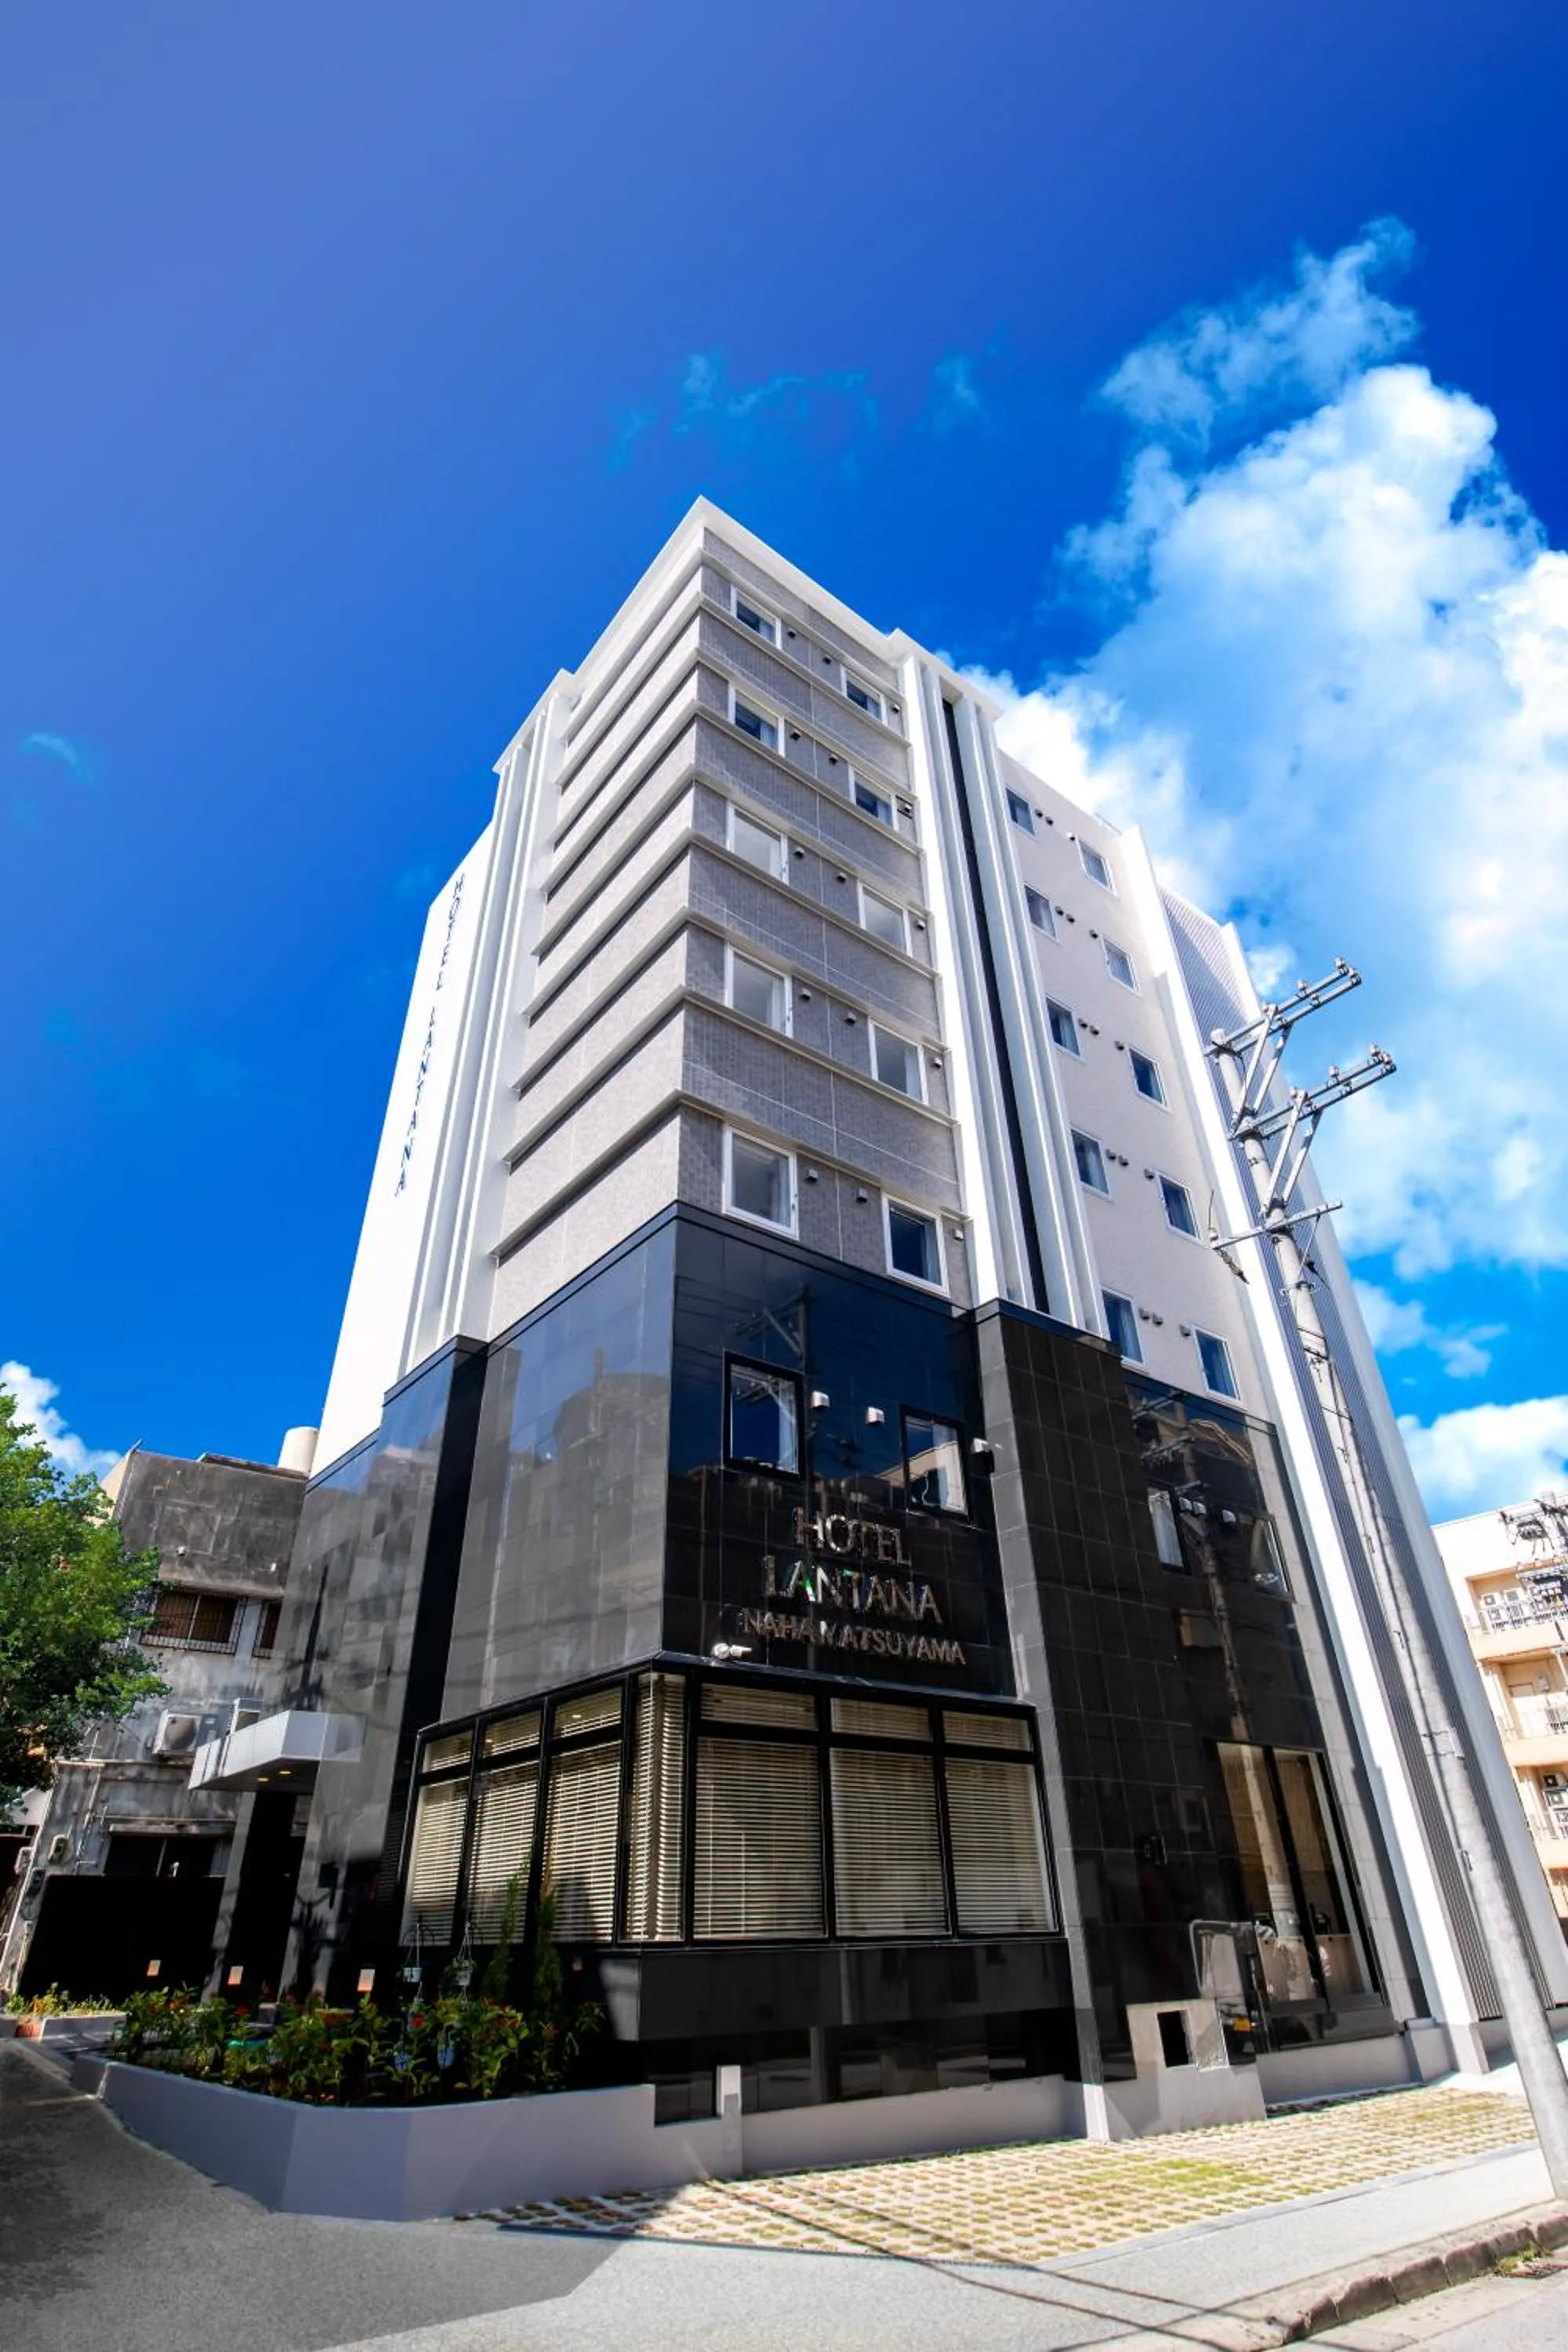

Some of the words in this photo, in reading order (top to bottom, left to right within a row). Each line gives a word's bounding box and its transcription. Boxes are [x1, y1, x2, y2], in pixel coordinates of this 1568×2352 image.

[436, 873, 465, 992] HOTEL
[793, 1506, 912, 1566] HOTEL
[762, 1555, 942, 1624] LANTANA
[741, 1608, 815, 1644] NAHA
[818, 1621, 966, 1665] MATSUYAMA
